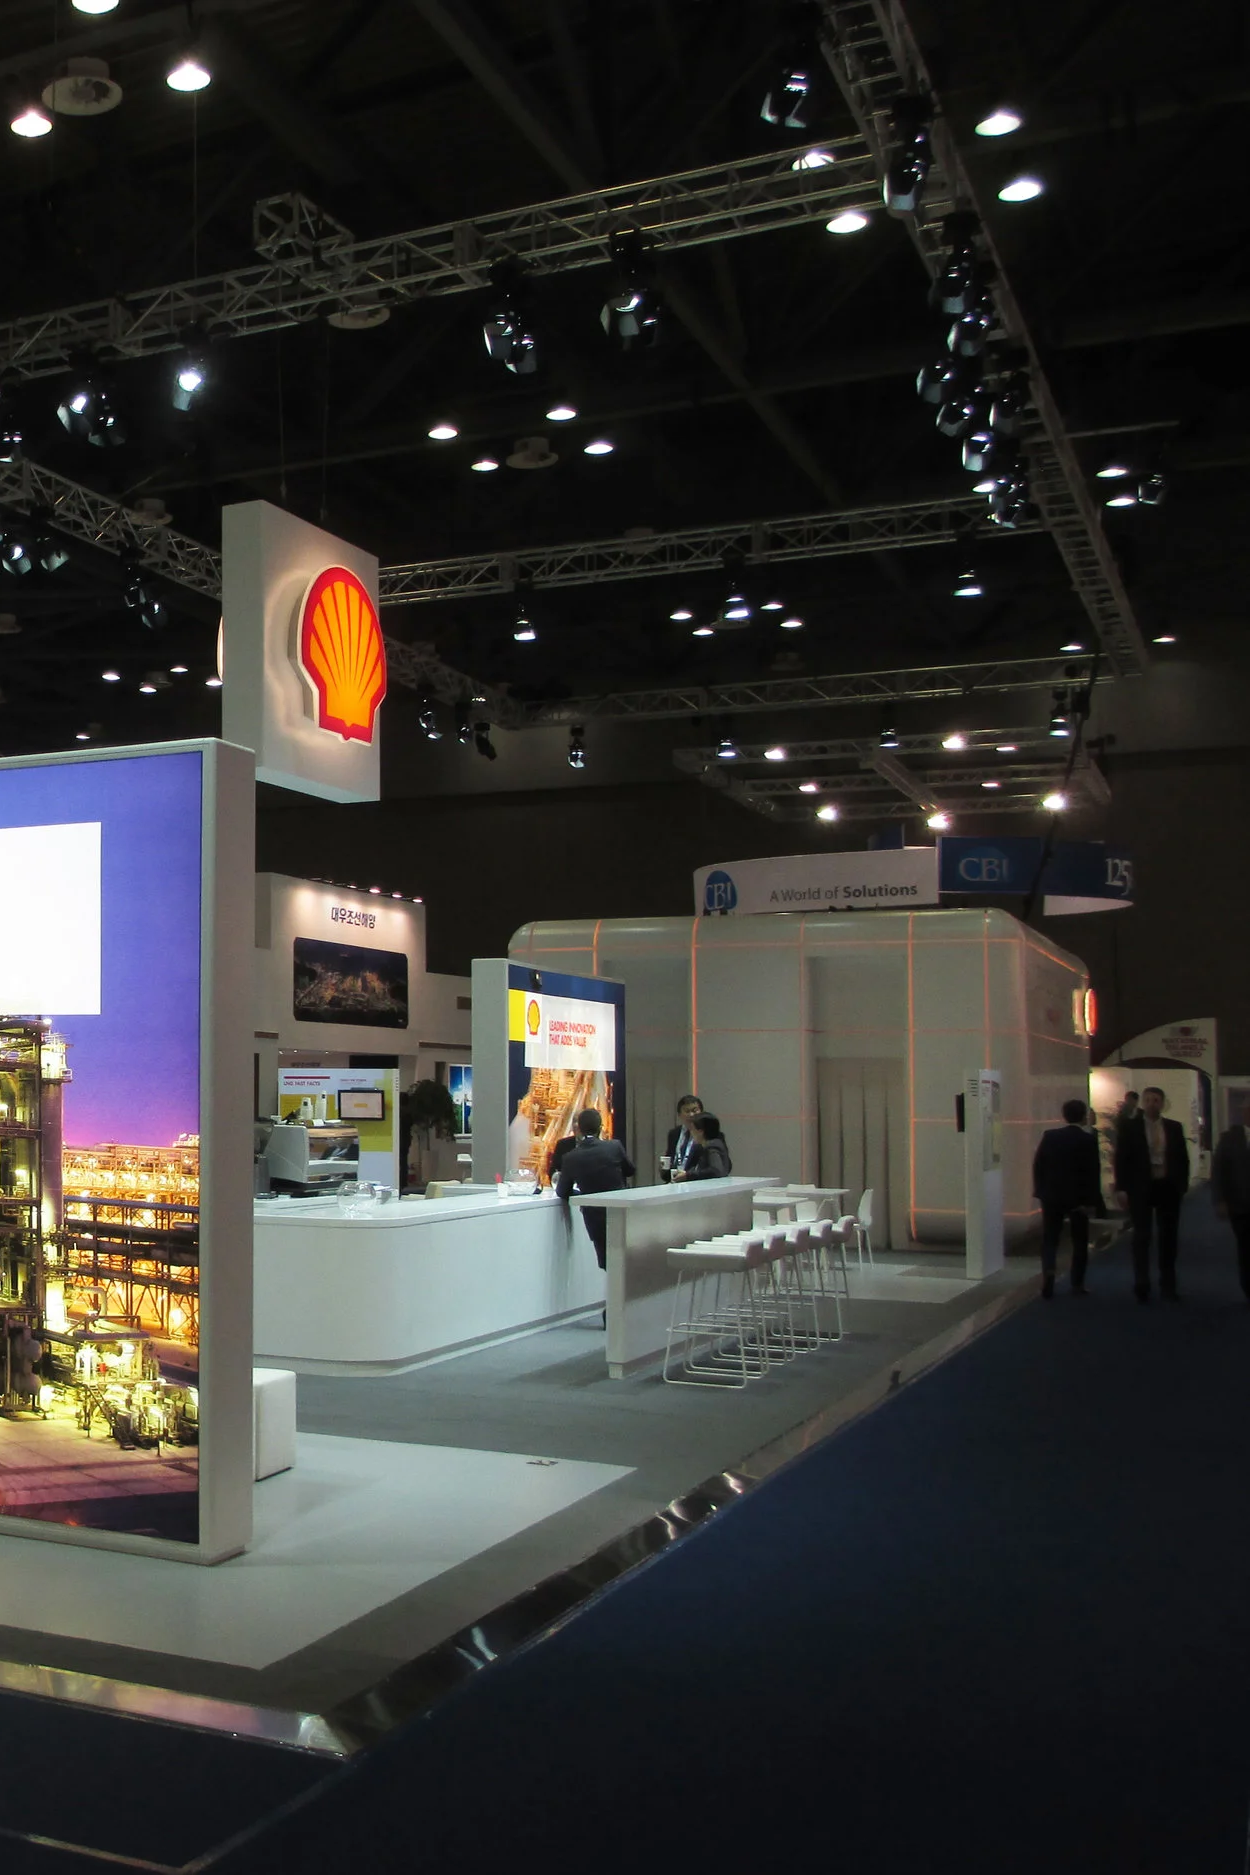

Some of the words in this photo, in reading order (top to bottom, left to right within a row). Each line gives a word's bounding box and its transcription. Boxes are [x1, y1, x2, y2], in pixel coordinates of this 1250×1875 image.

[959, 857, 1009, 882] CBI
[1105, 858, 1134, 896] 125
[706, 882, 732, 910] CBI
[770, 890, 779, 902] A
[781, 887, 821, 901] World
[824, 886, 840, 899] of
[842, 884, 918, 898] Solutions
[331, 907, 376, 929] 대우조선해양
